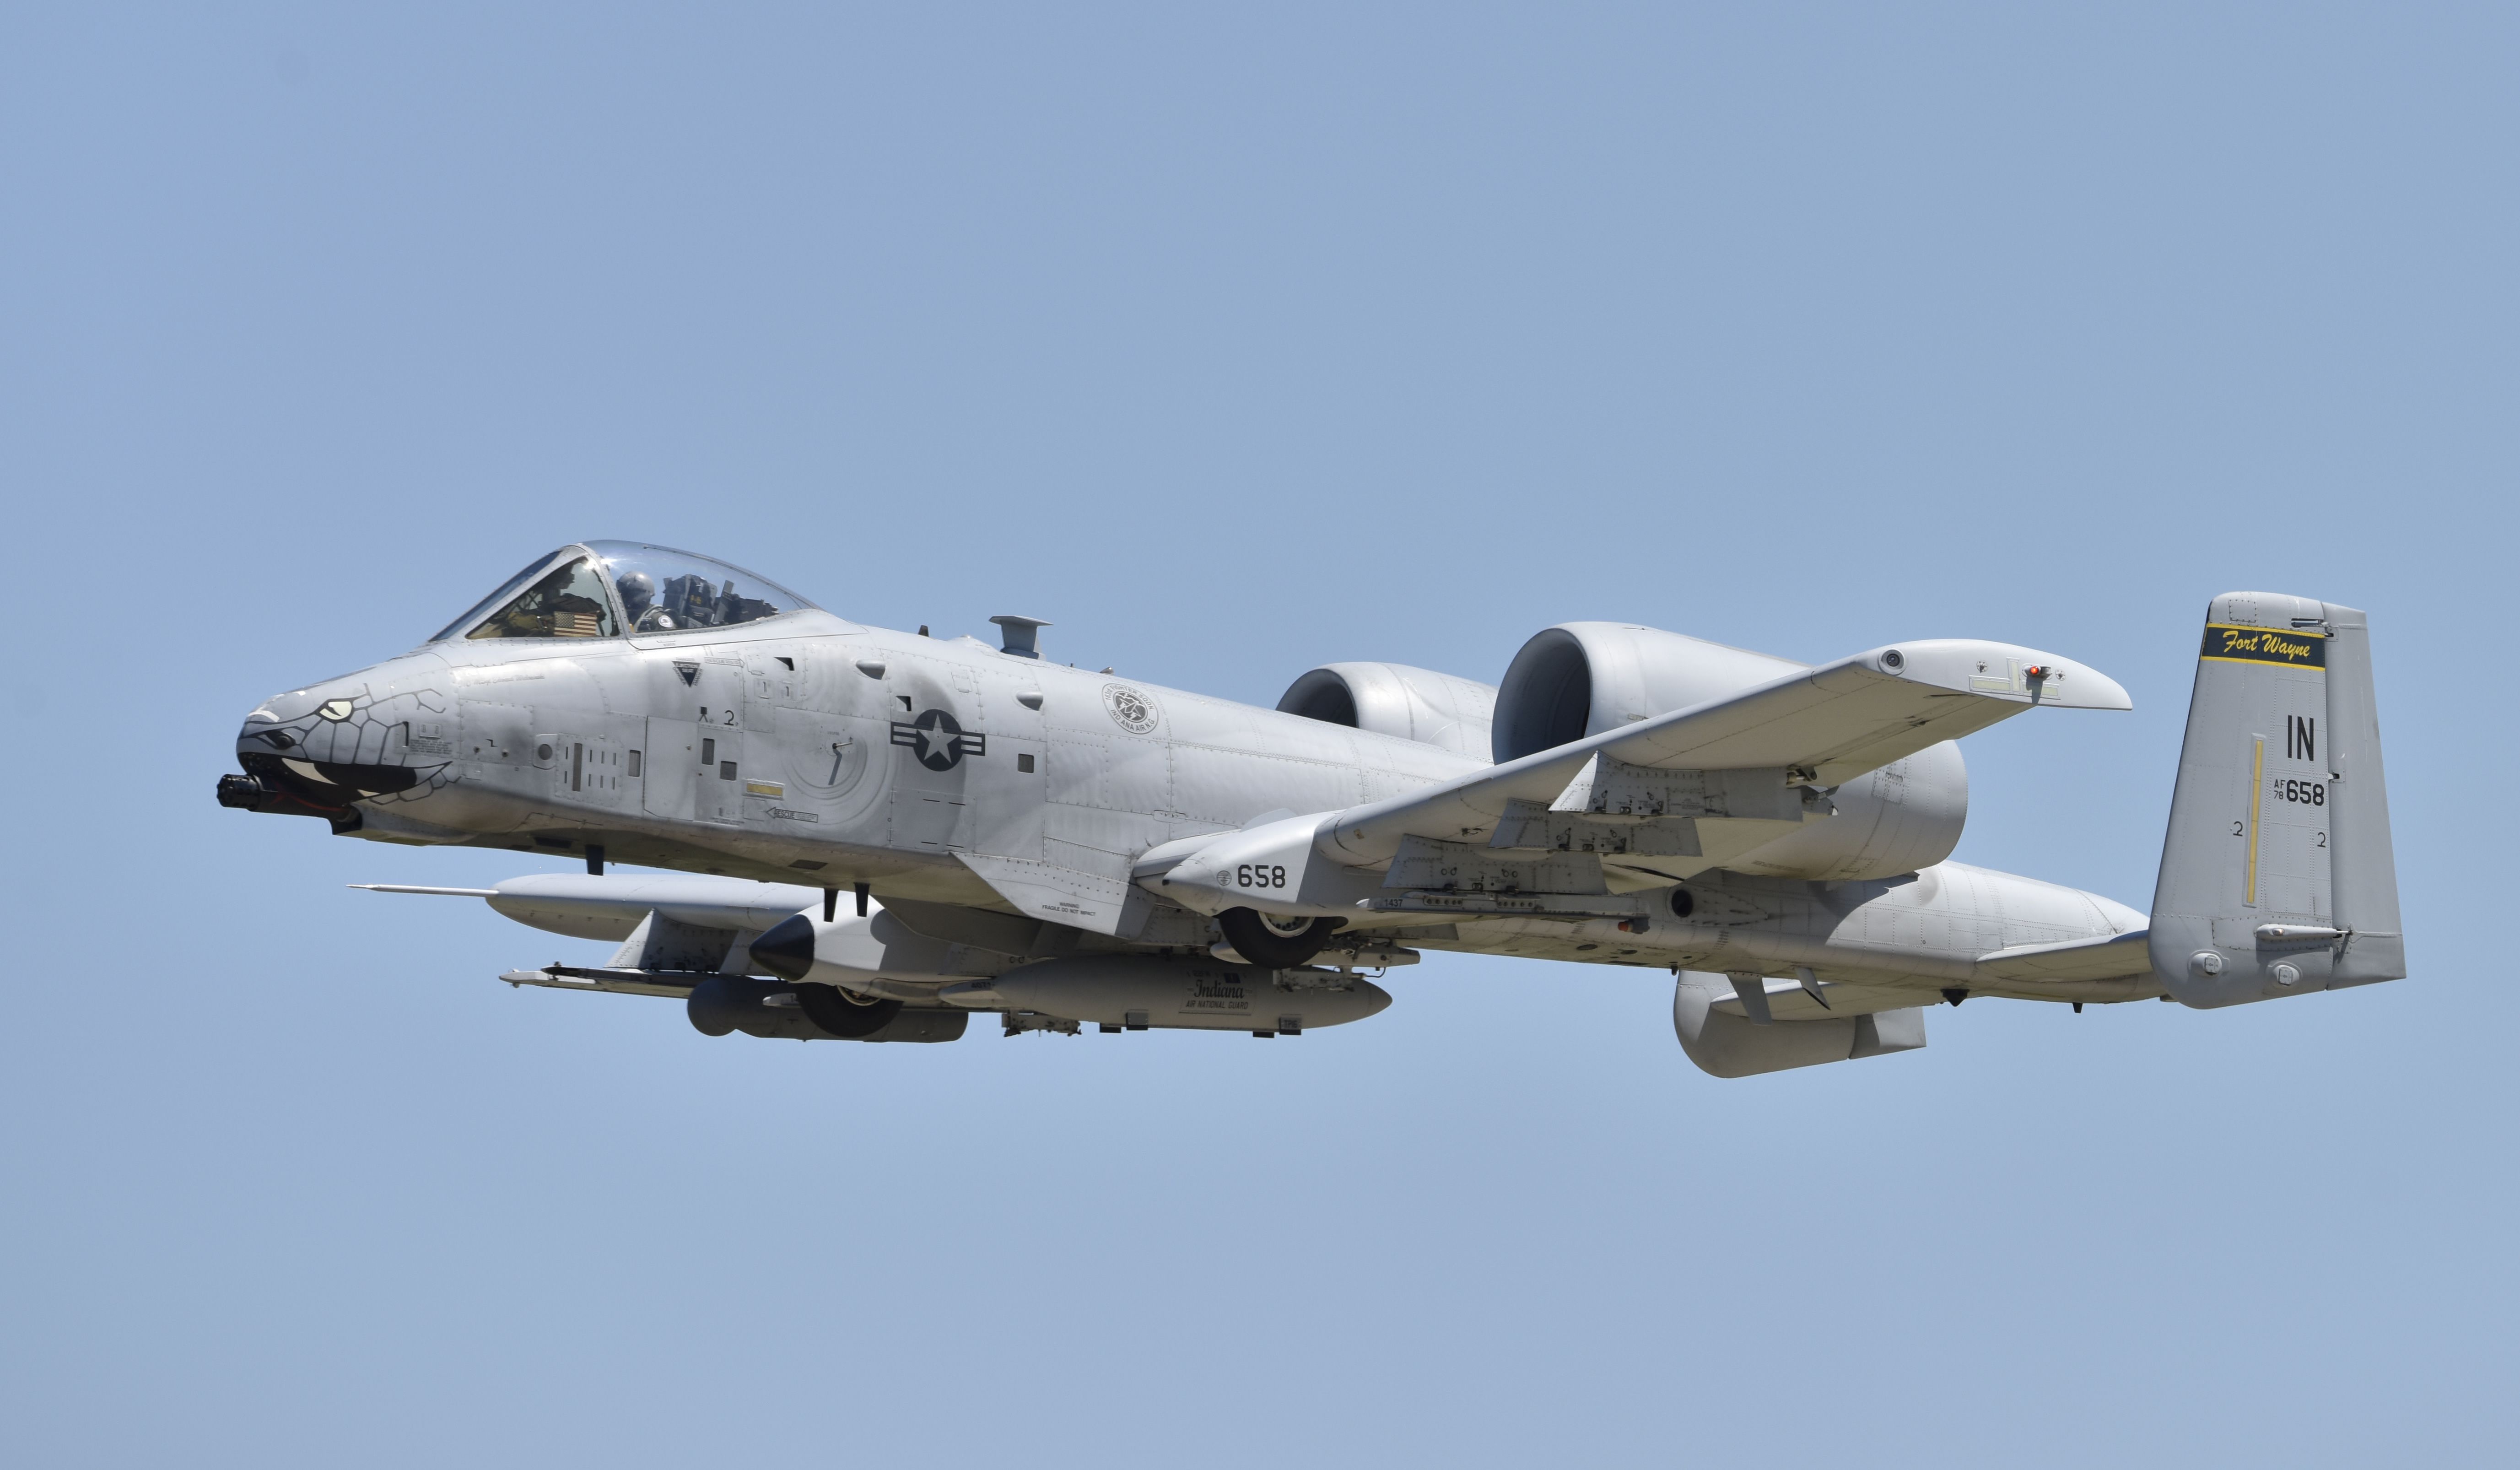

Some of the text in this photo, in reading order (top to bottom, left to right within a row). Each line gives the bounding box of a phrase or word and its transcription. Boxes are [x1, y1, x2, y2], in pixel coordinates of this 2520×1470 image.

[2223, 631, 2310, 660] Fort Wayne
[1110, 686, 1138, 695] FIGHTER
[1110, 709, 1134, 731] INDANA
[2288, 714, 2314, 762] IN
[2274, 778, 2286, 789] AF
[2273, 790, 2284, 800] 78
[2286, 779, 2325, 806] 658
[774, 810, 795, 818] RESCUE
[1237, 864, 1286, 888] 658
[1384, 898, 1403, 907] 1437
[1193, 978, 1245, 999] Indiana
[1186, 1000, 1249, 1010] AIR NATIONAL GUARD
